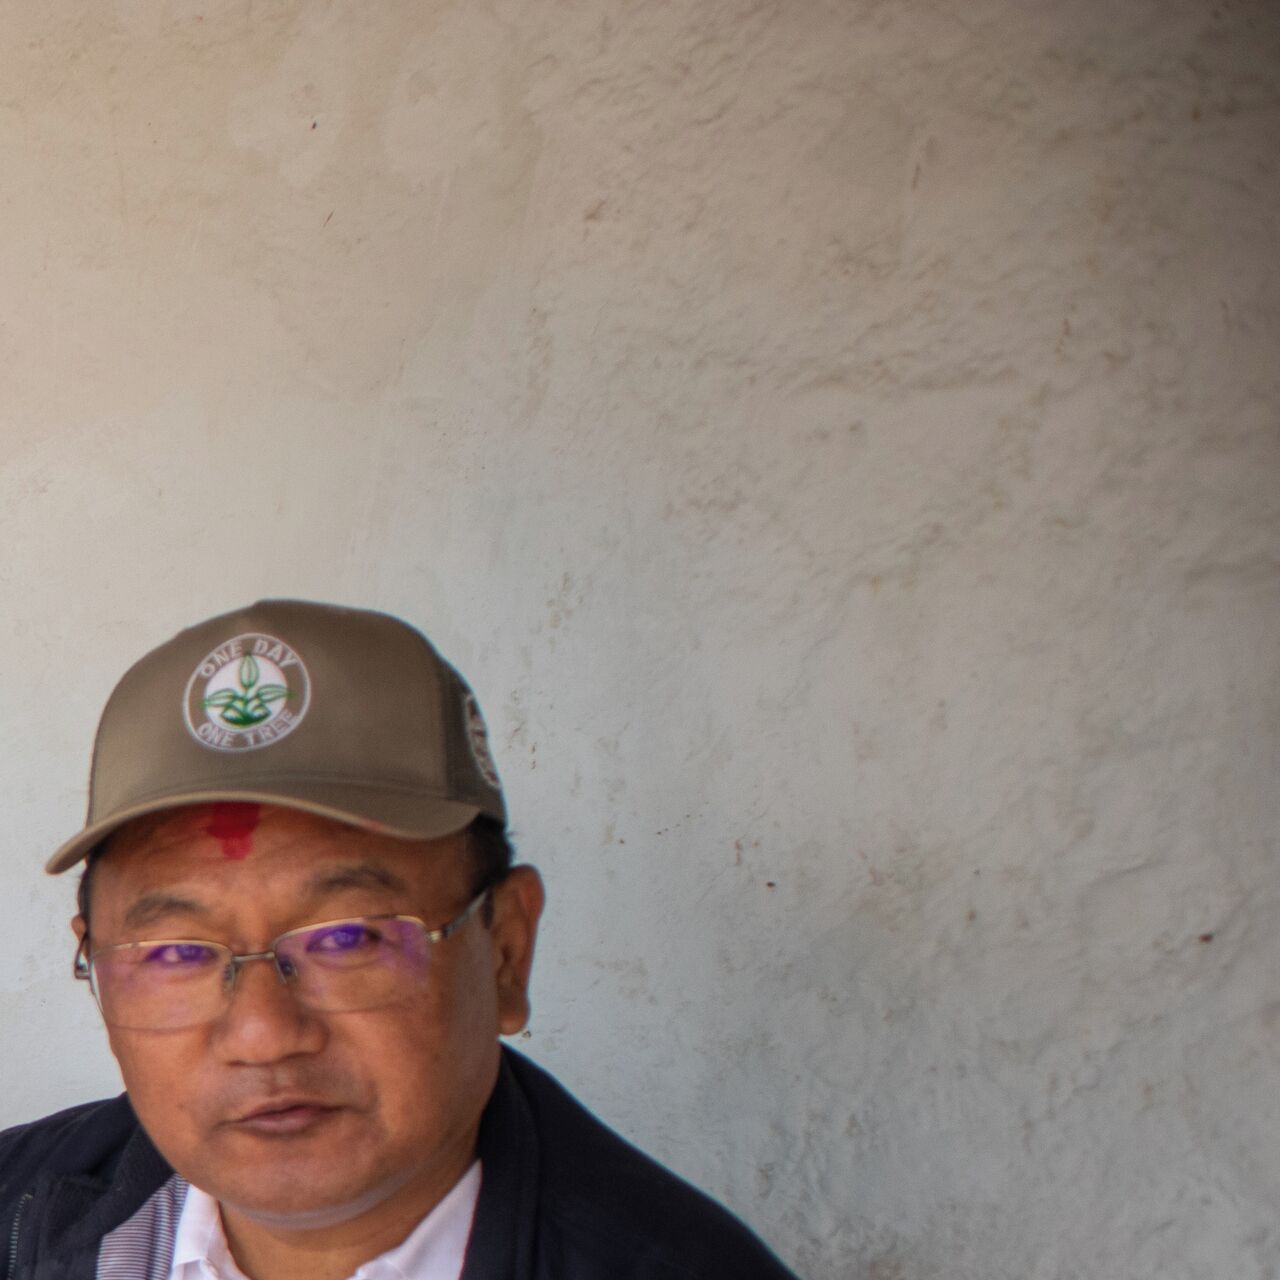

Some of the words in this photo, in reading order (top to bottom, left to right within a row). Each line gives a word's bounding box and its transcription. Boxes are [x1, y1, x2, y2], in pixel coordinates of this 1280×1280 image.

[200, 639, 242, 679] ONE
[254, 639, 298, 668] DAY
[198, 722, 234, 747] ONE
[244, 709, 299, 747] TREE
